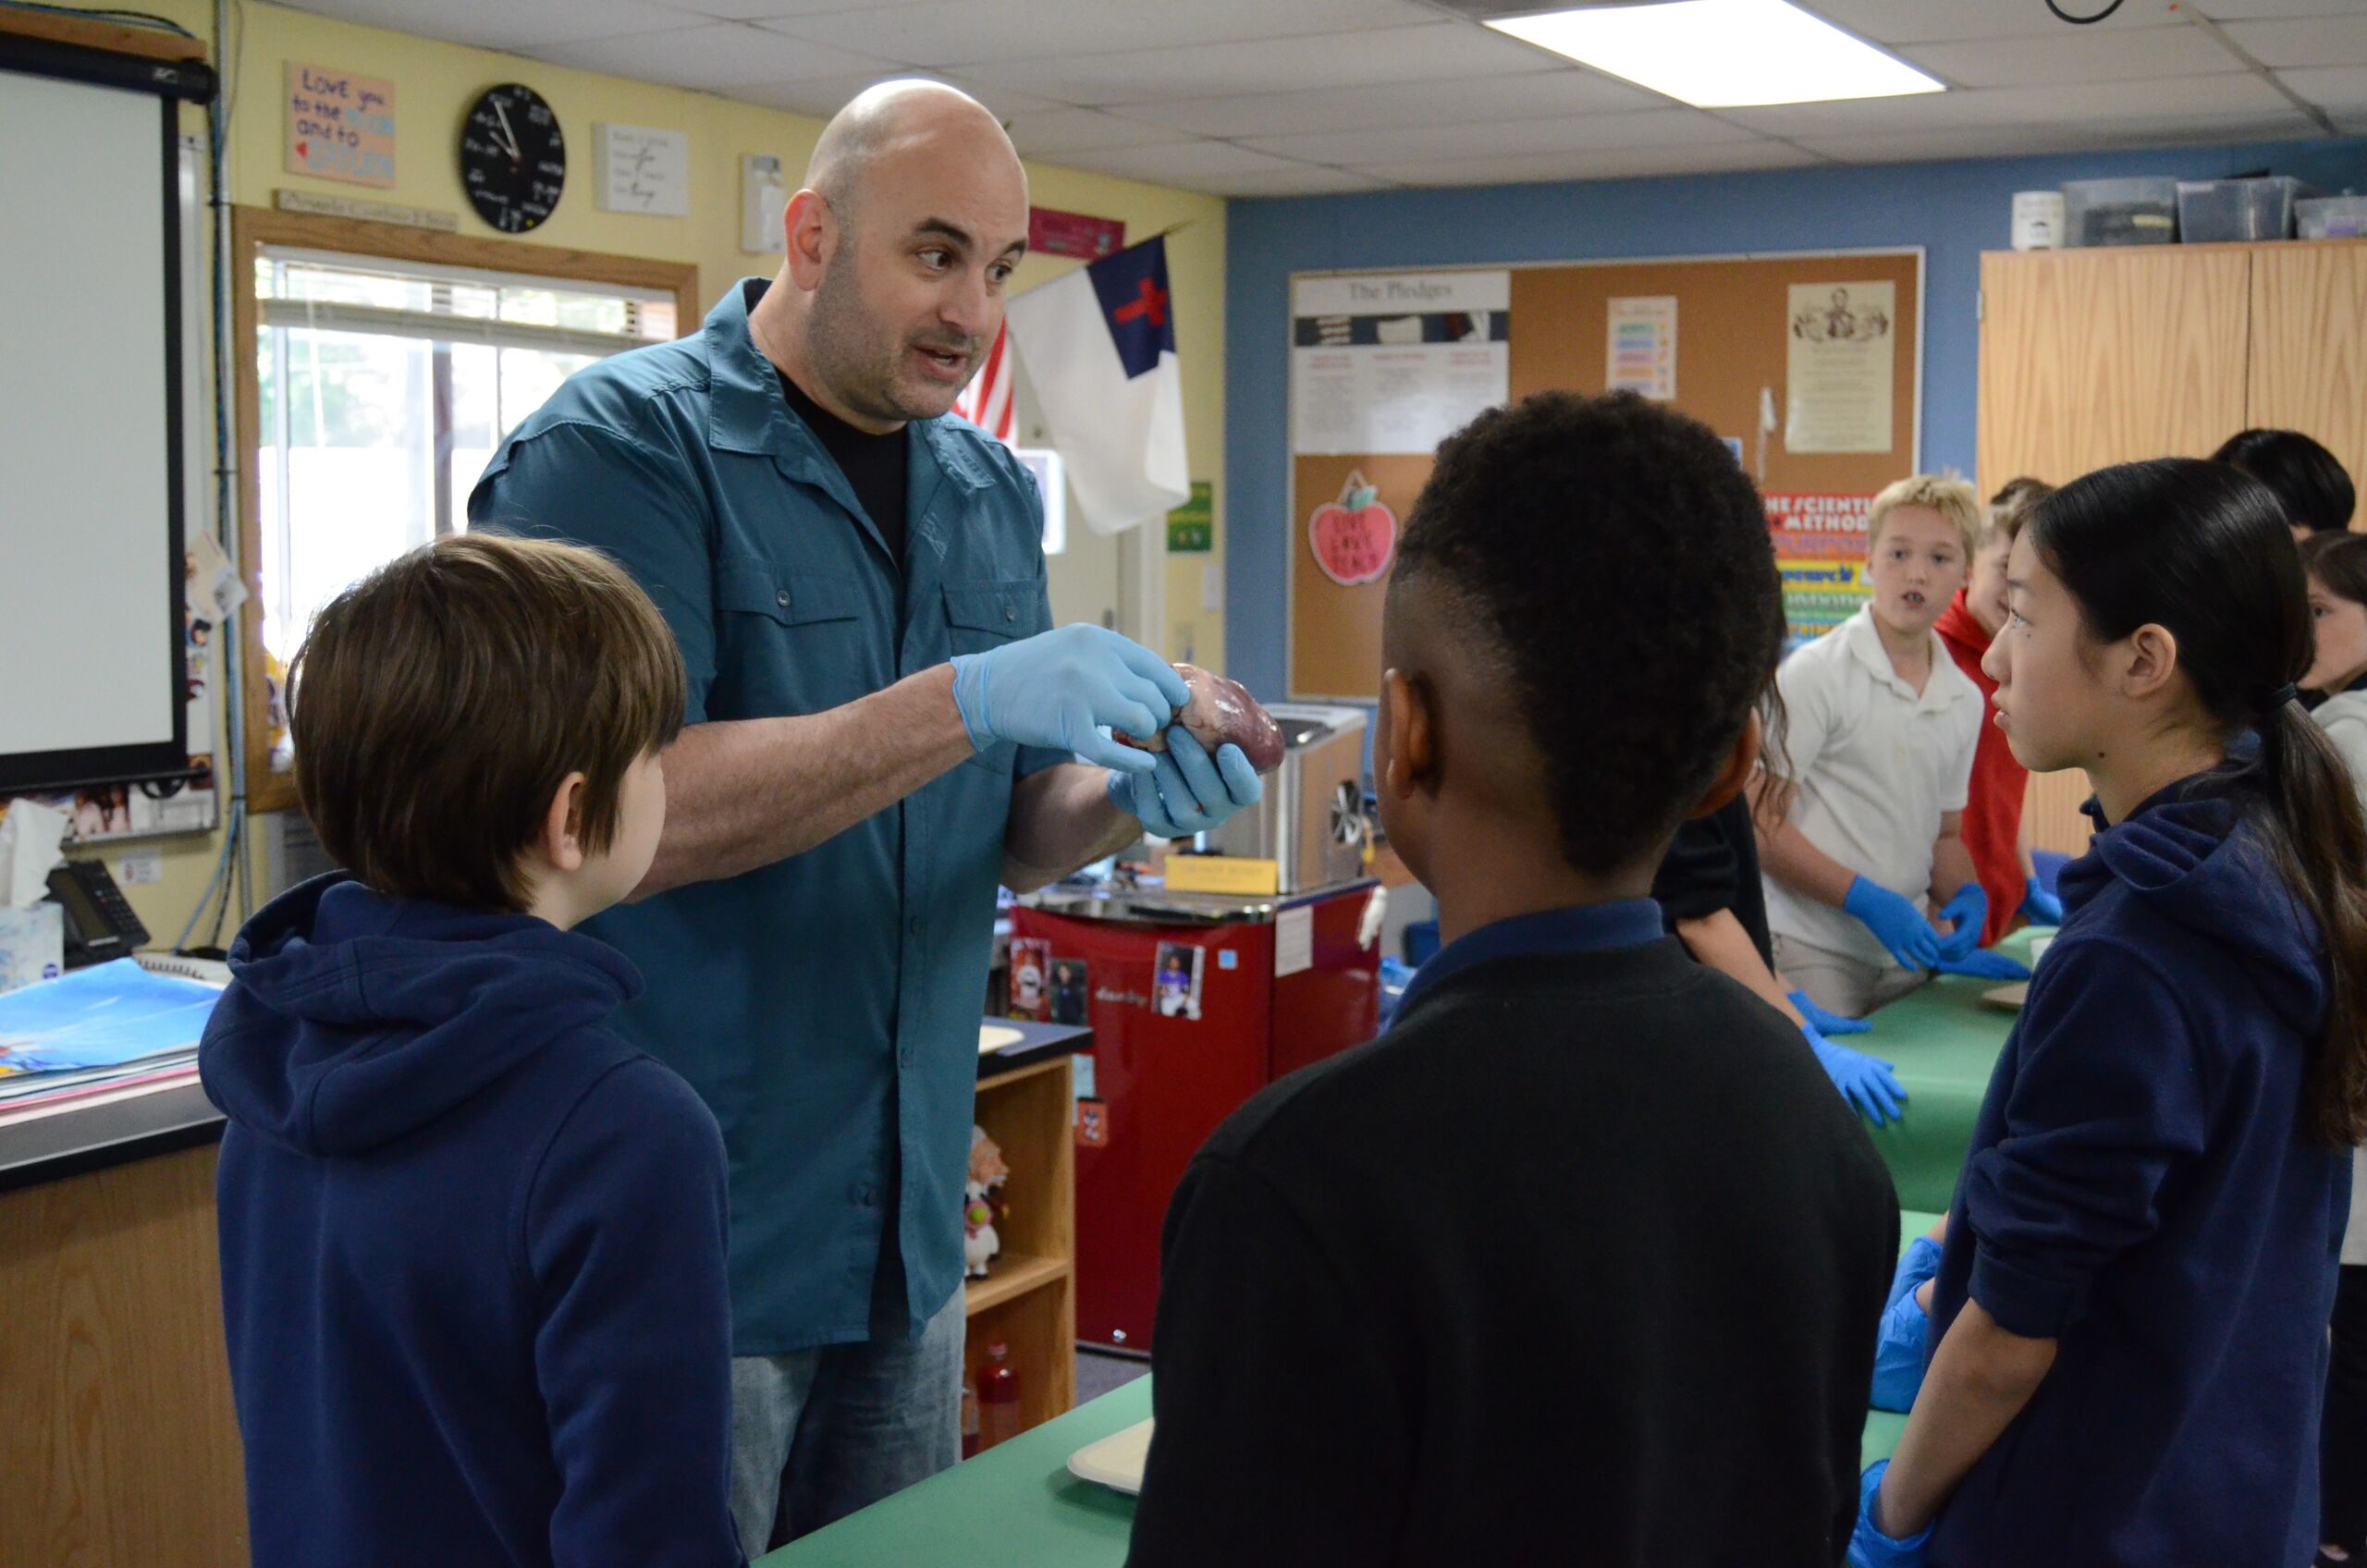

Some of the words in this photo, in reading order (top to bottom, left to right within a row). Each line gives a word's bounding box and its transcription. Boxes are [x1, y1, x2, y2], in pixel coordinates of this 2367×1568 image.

[291, 94, 311, 112] to
[314, 103, 341, 121] the
[358, 91, 385, 113] you
[297, 118, 332, 140] and
[337, 127, 360, 148] to
[1350, 283, 1380, 300] The
[1386, 280, 1453, 300] Pledges
[1765, 496, 1791, 514] HE
[1794, 496, 1873, 514] SCIENTI
